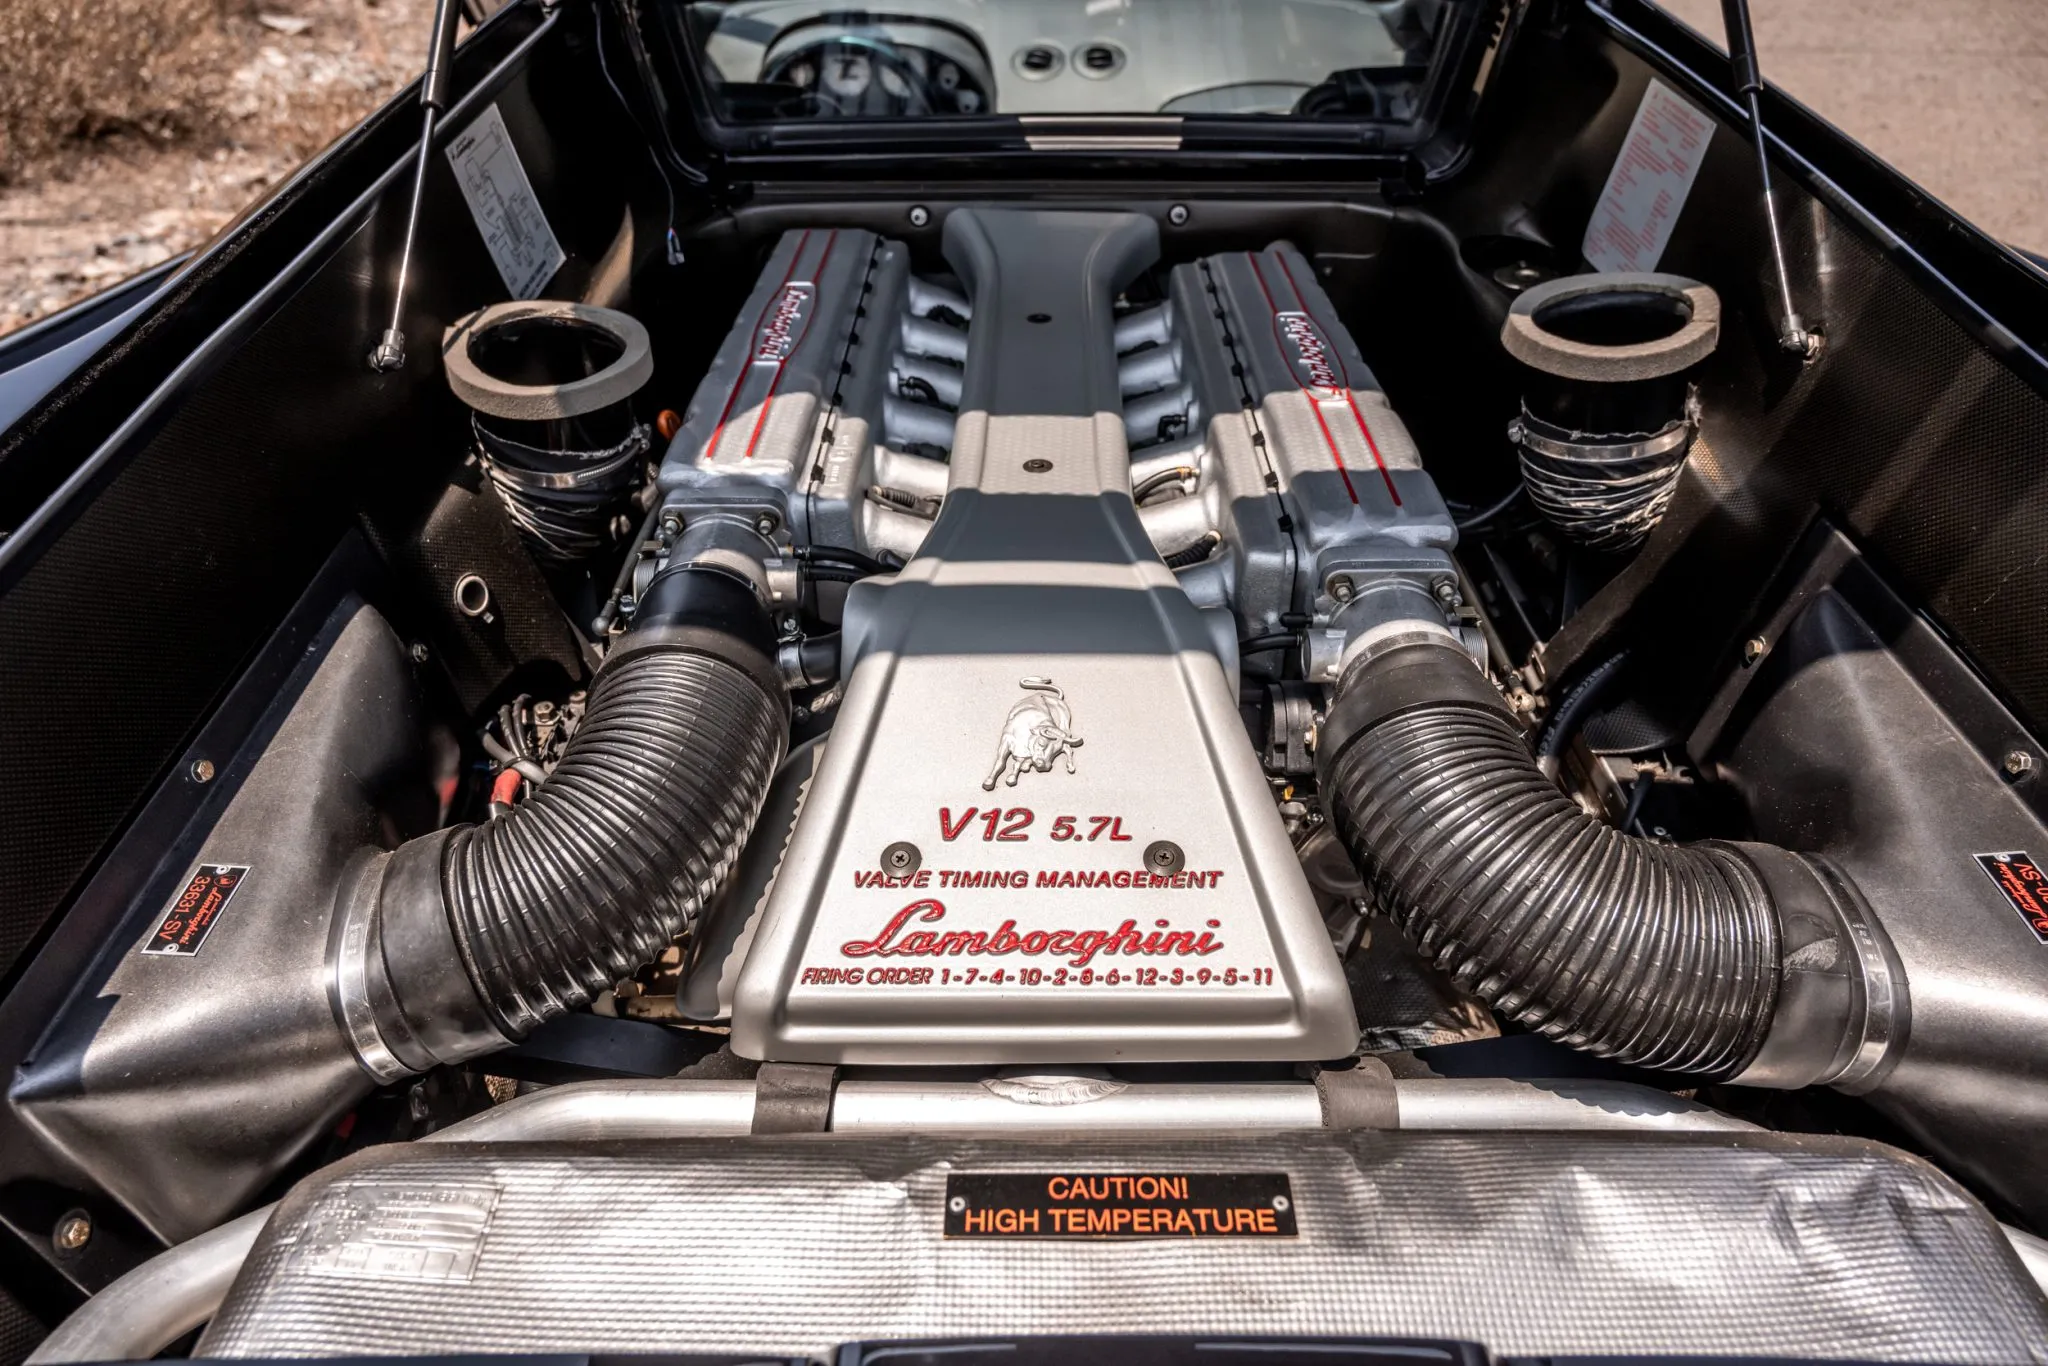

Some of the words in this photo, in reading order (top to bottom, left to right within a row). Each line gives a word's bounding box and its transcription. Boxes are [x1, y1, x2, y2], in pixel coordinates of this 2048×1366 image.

[939, 807, 1035, 842] V12
[1050, 816, 1133, 841] 5.7L
[854, 870, 932, 888] VALVE
[939, 870, 1029, 889] TIMING
[1035, 870, 1224, 889] MANAGEMENT
[159, 876, 211, 941] 33631-SV
[179, 887, 223, 945] Lamborghini
[839, 898, 1224, 968] Lamborghini
[800, 967, 865, 985] FIRING
[866, 967, 934, 985] ORDER
[1048, 1176, 1188, 1200] CAUTION!
[964, 1208, 1040, 1233] HIGH
[1048, 1208, 1278, 1233] TEMPERATURE
